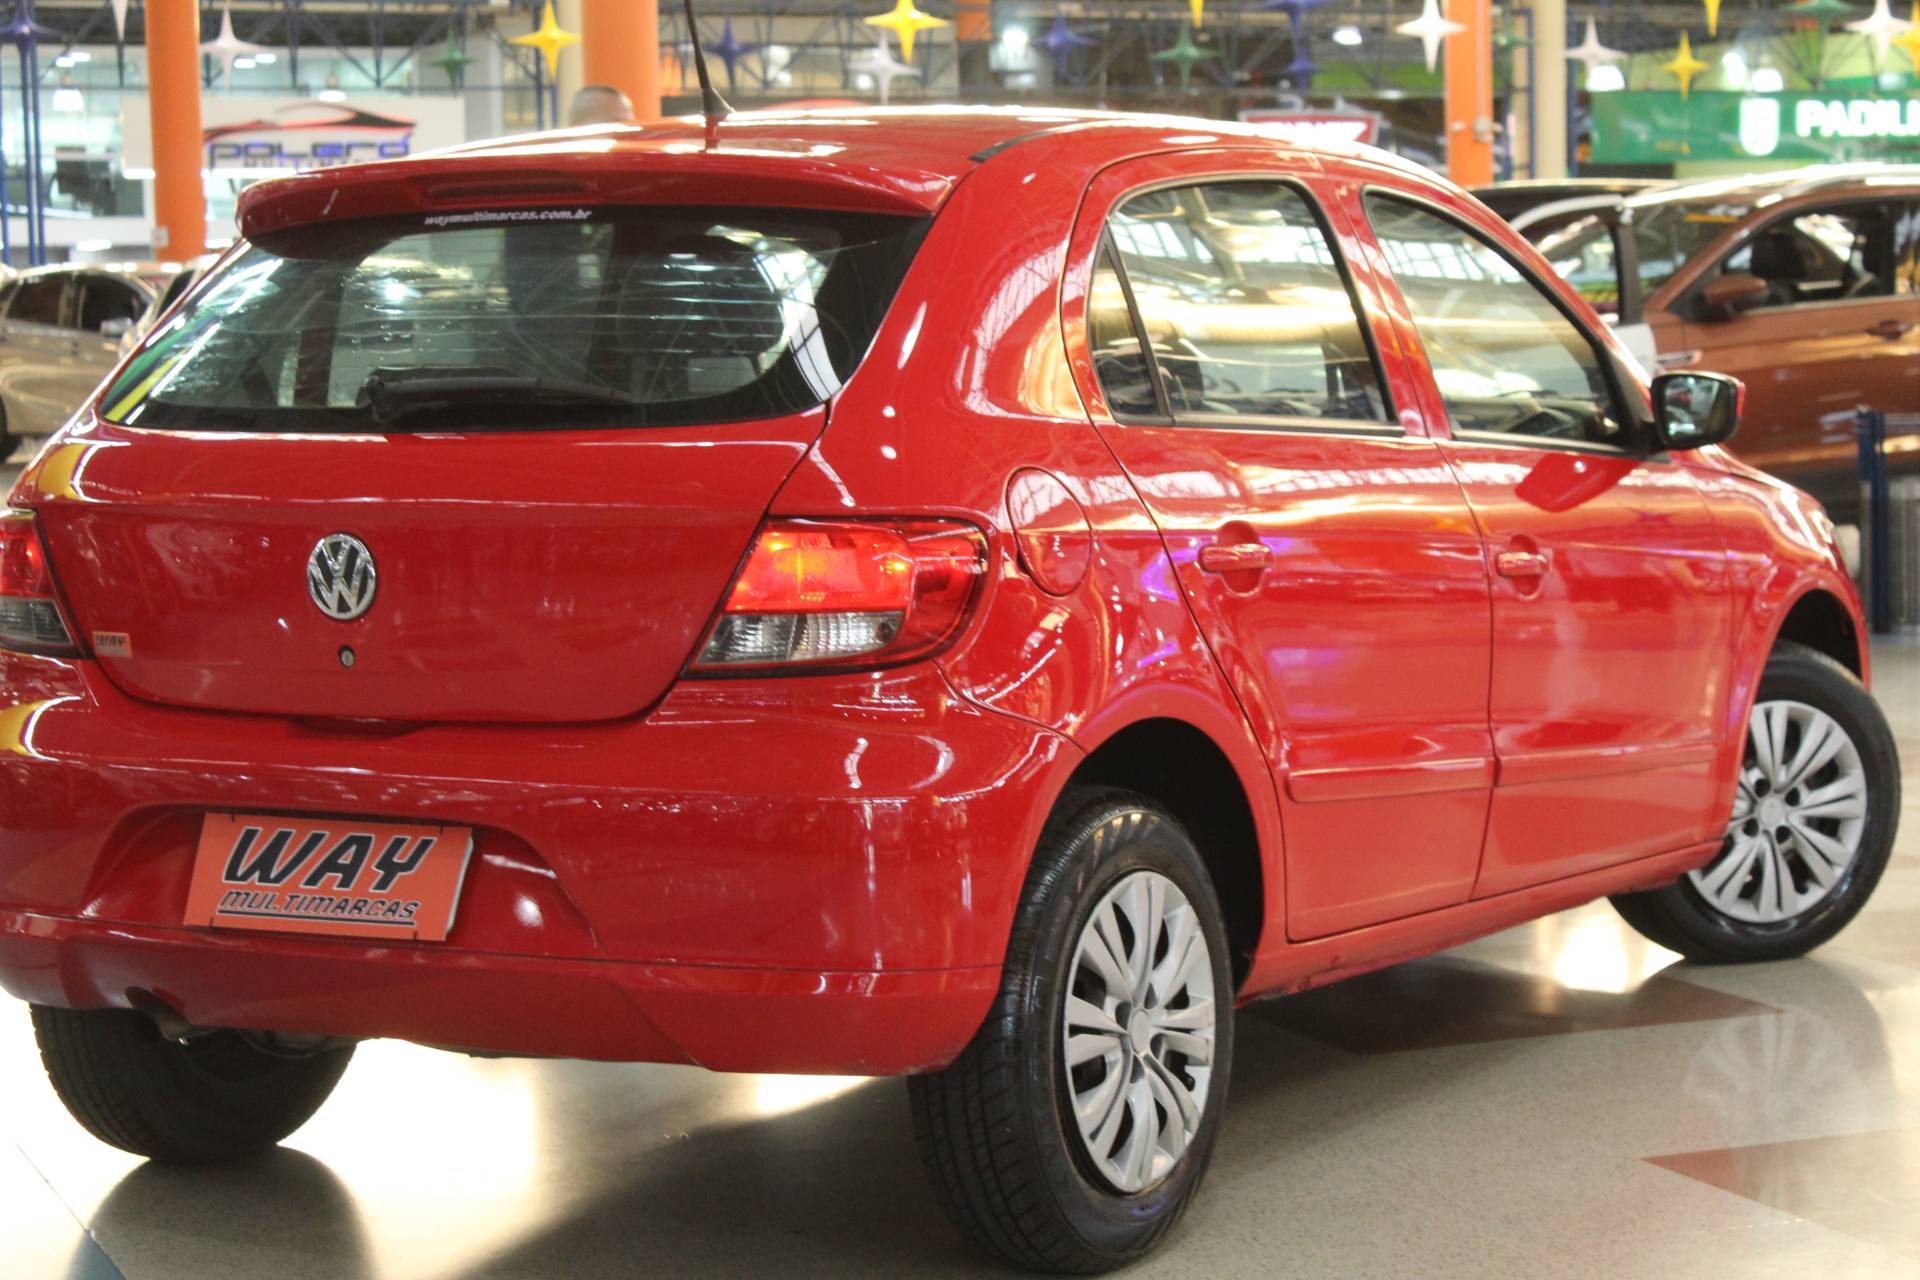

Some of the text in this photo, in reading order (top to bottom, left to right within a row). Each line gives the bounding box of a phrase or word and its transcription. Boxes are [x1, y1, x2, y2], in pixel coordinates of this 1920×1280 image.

[424, 208, 592, 226] waymultimarcas.com.br
[222, 826, 438, 893] WAY
[218, 890, 421, 920] MULTIMARCAS
